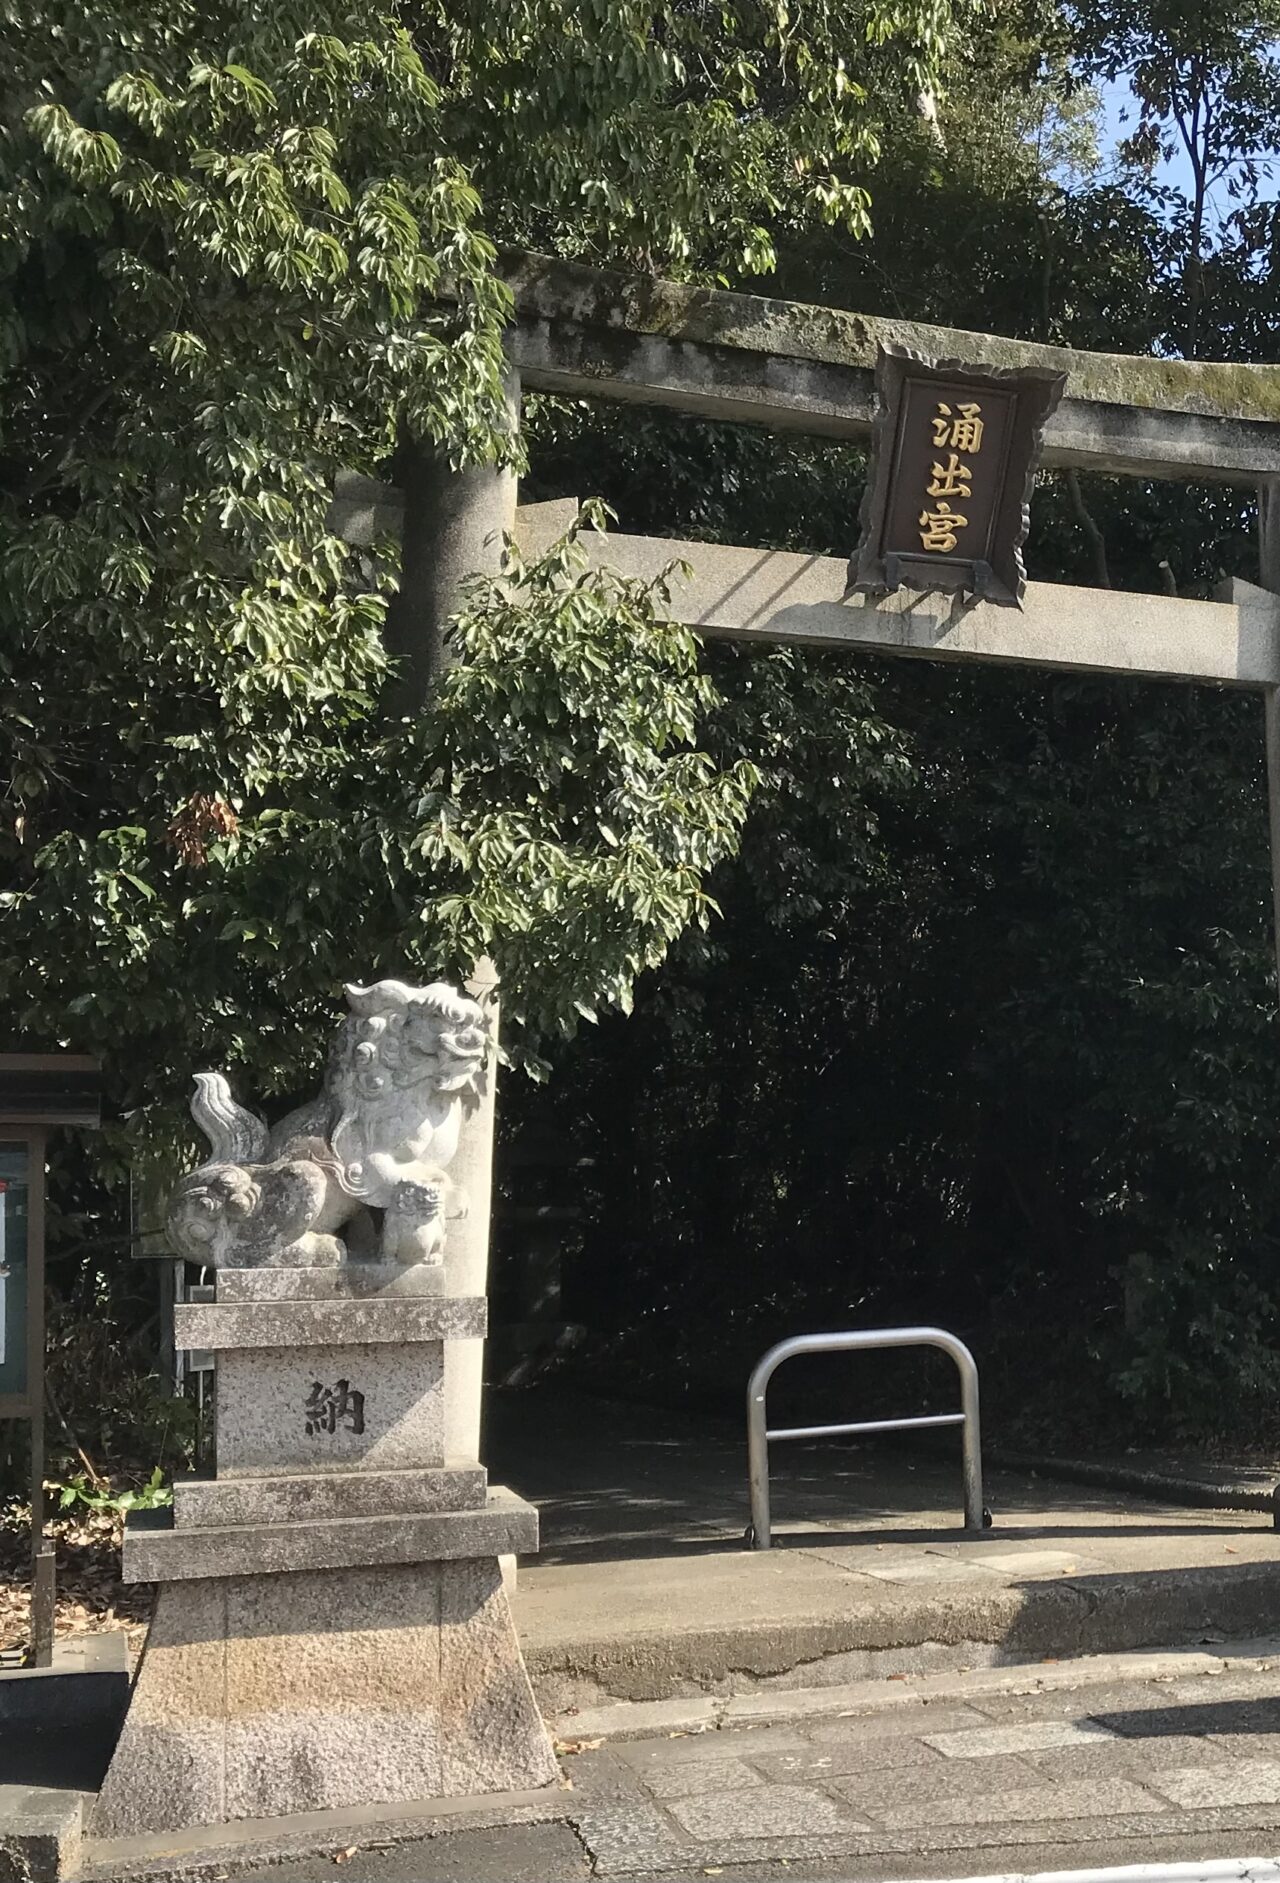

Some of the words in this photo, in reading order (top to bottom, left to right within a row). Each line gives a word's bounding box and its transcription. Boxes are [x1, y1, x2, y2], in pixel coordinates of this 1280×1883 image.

[919, 401, 984, 552] 涌出宮
[304, 1378, 365, 1436] 納
